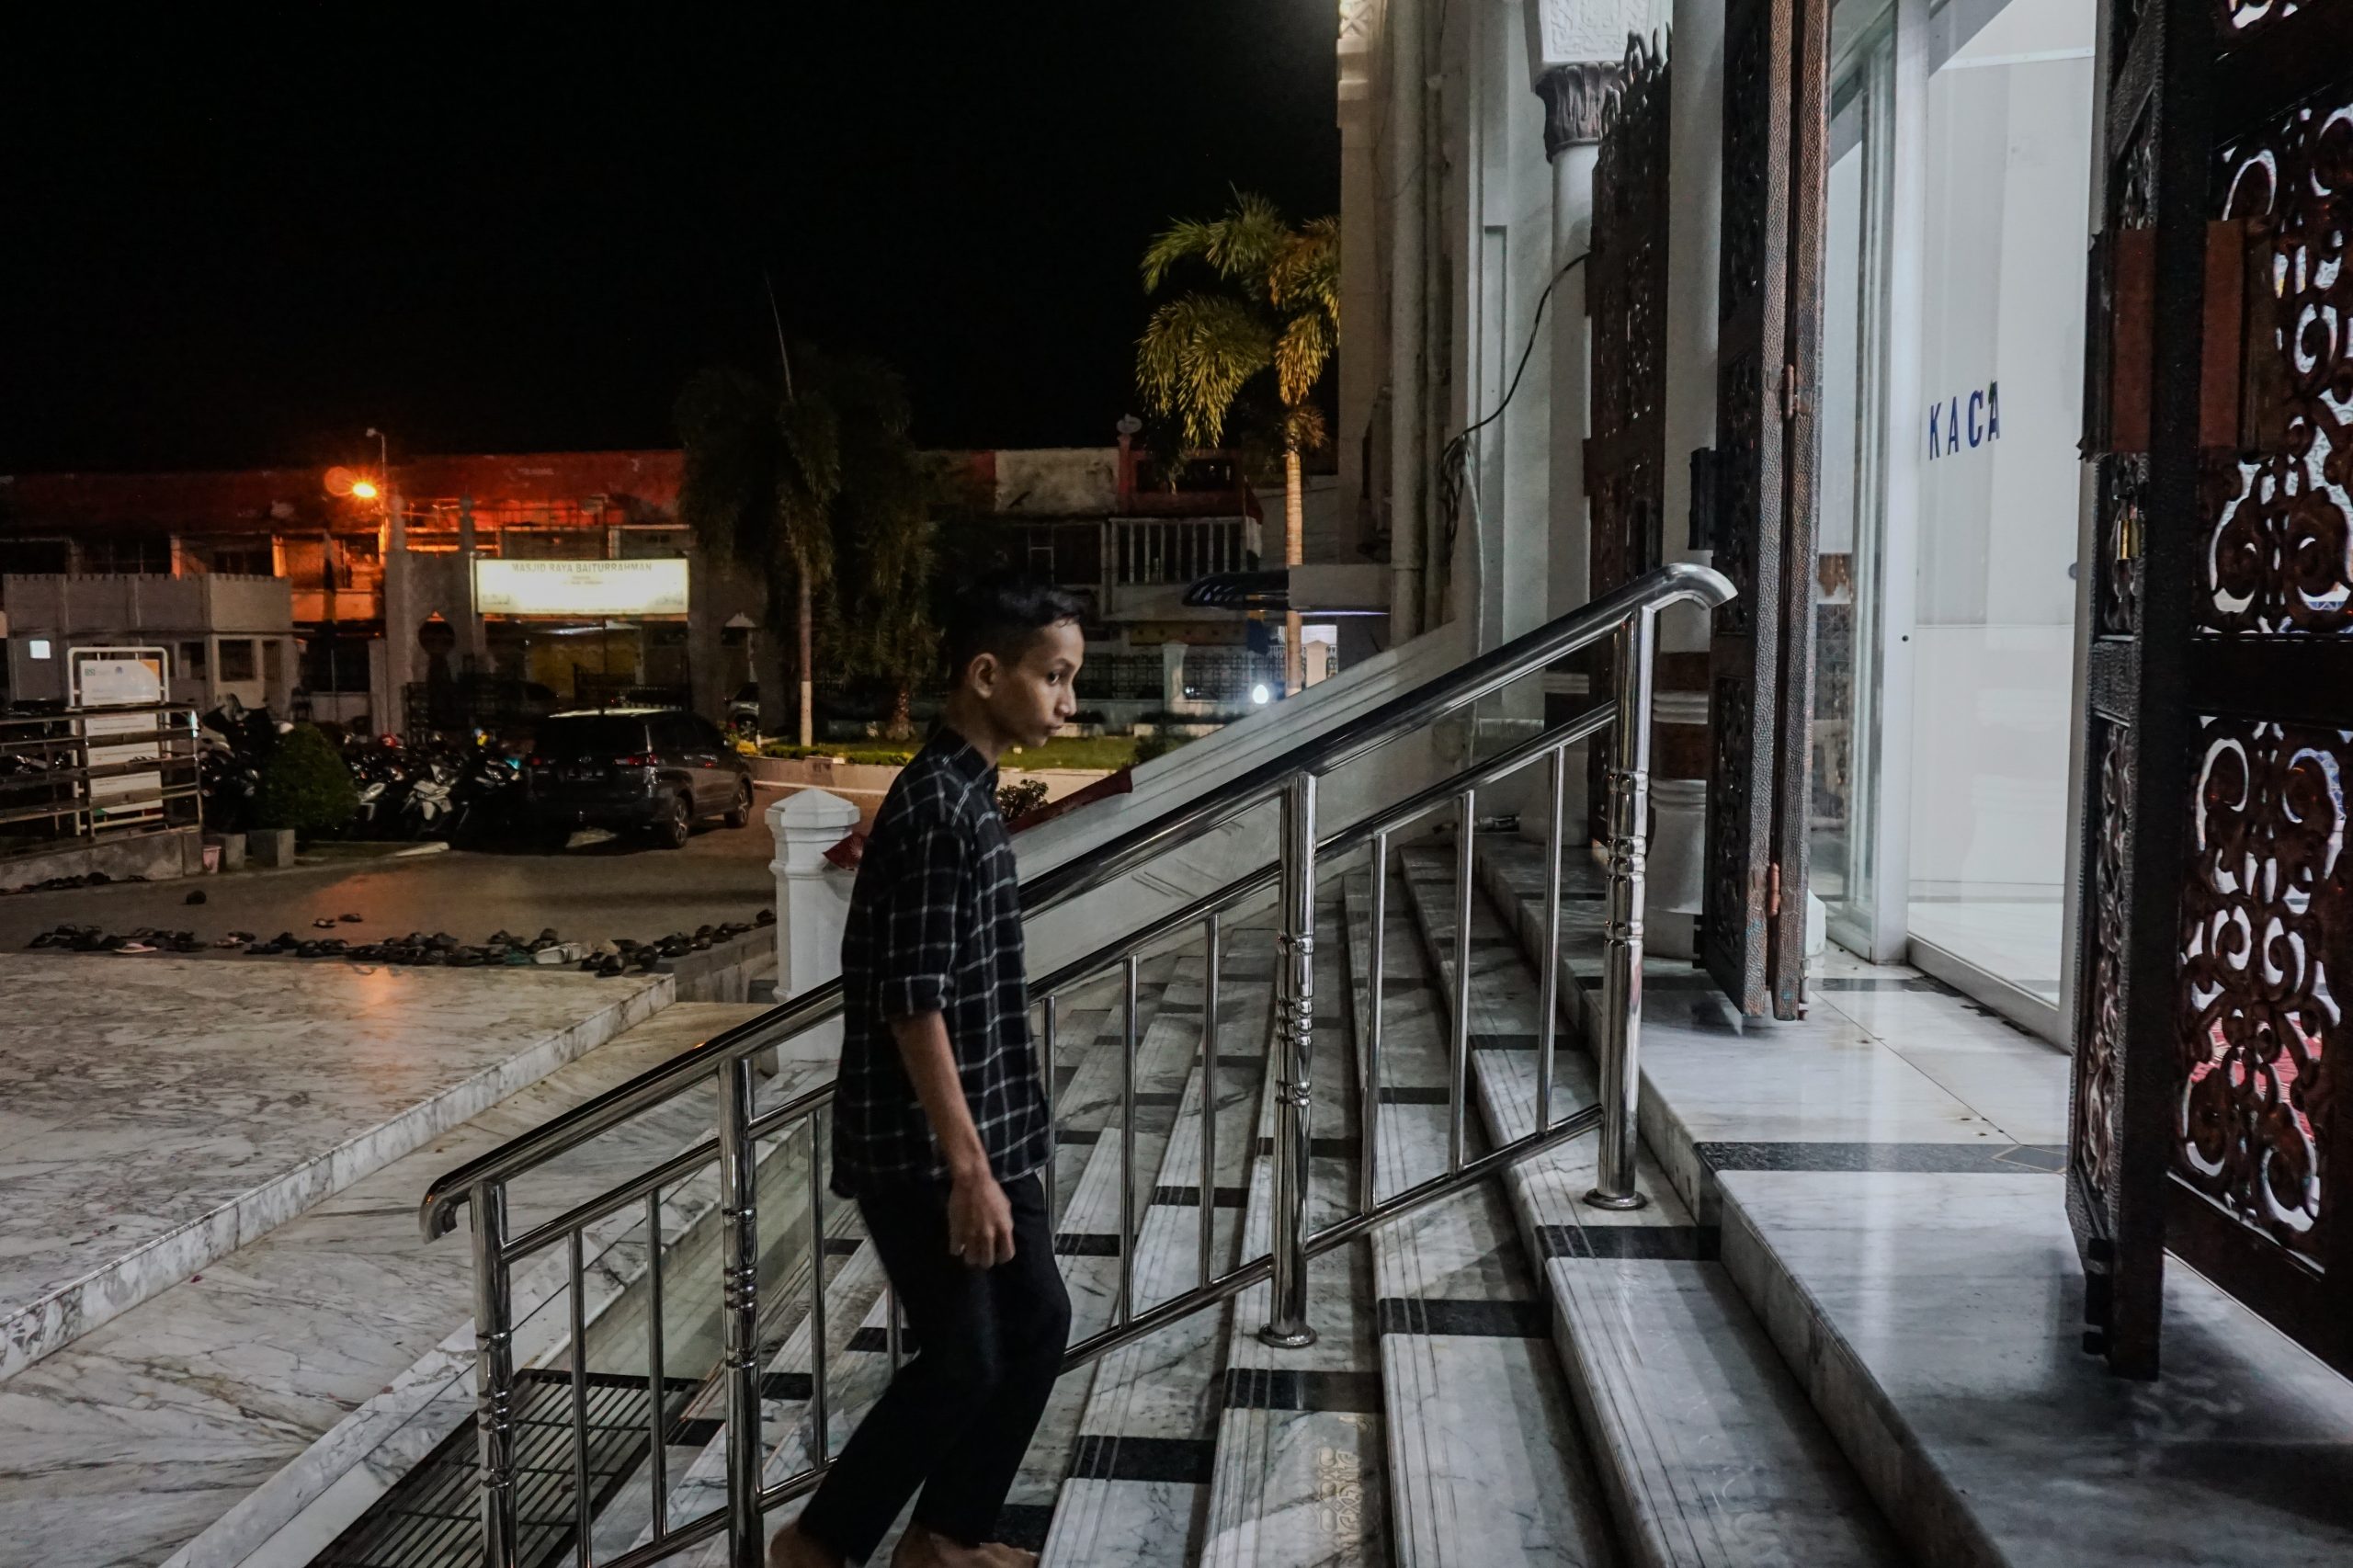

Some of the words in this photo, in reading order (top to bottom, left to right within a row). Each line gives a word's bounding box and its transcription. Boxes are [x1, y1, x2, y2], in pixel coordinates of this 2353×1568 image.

[1929, 380, 2000, 460] KACA
[512, 562, 546, 573] MASJID
[550, 562, 574, 573] RAYA
[575, 562, 652, 573] BAITURRAHMAN
